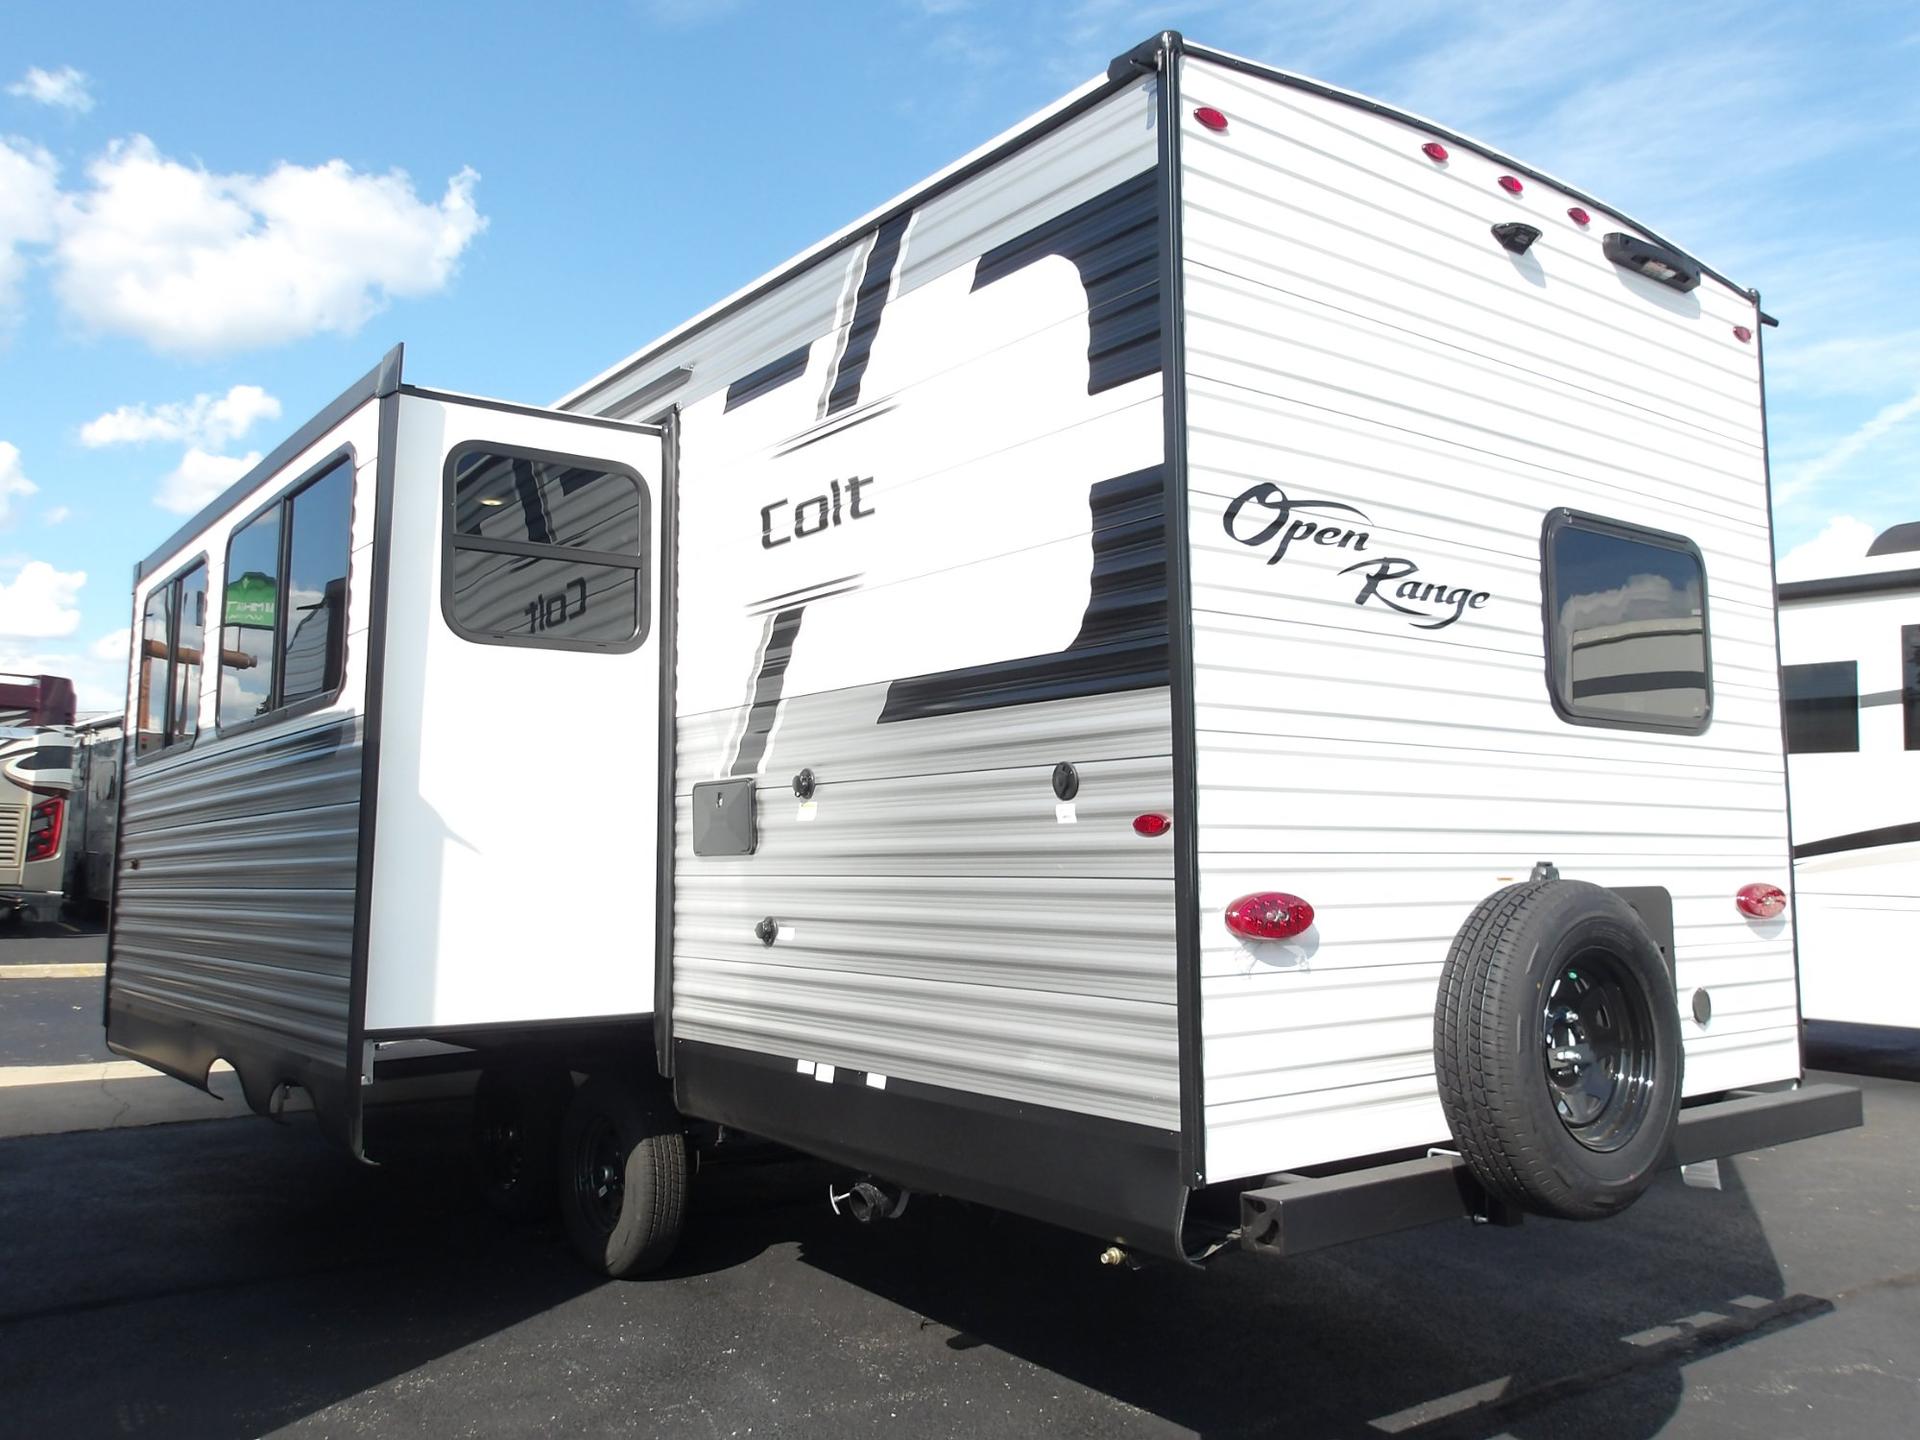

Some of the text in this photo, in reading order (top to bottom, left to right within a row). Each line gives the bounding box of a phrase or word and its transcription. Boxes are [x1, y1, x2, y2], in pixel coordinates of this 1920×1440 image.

[761, 476, 875, 550] Colt
[1223, 482, 1374, 565] Open
[1337, 557, 1490, 629] Range
